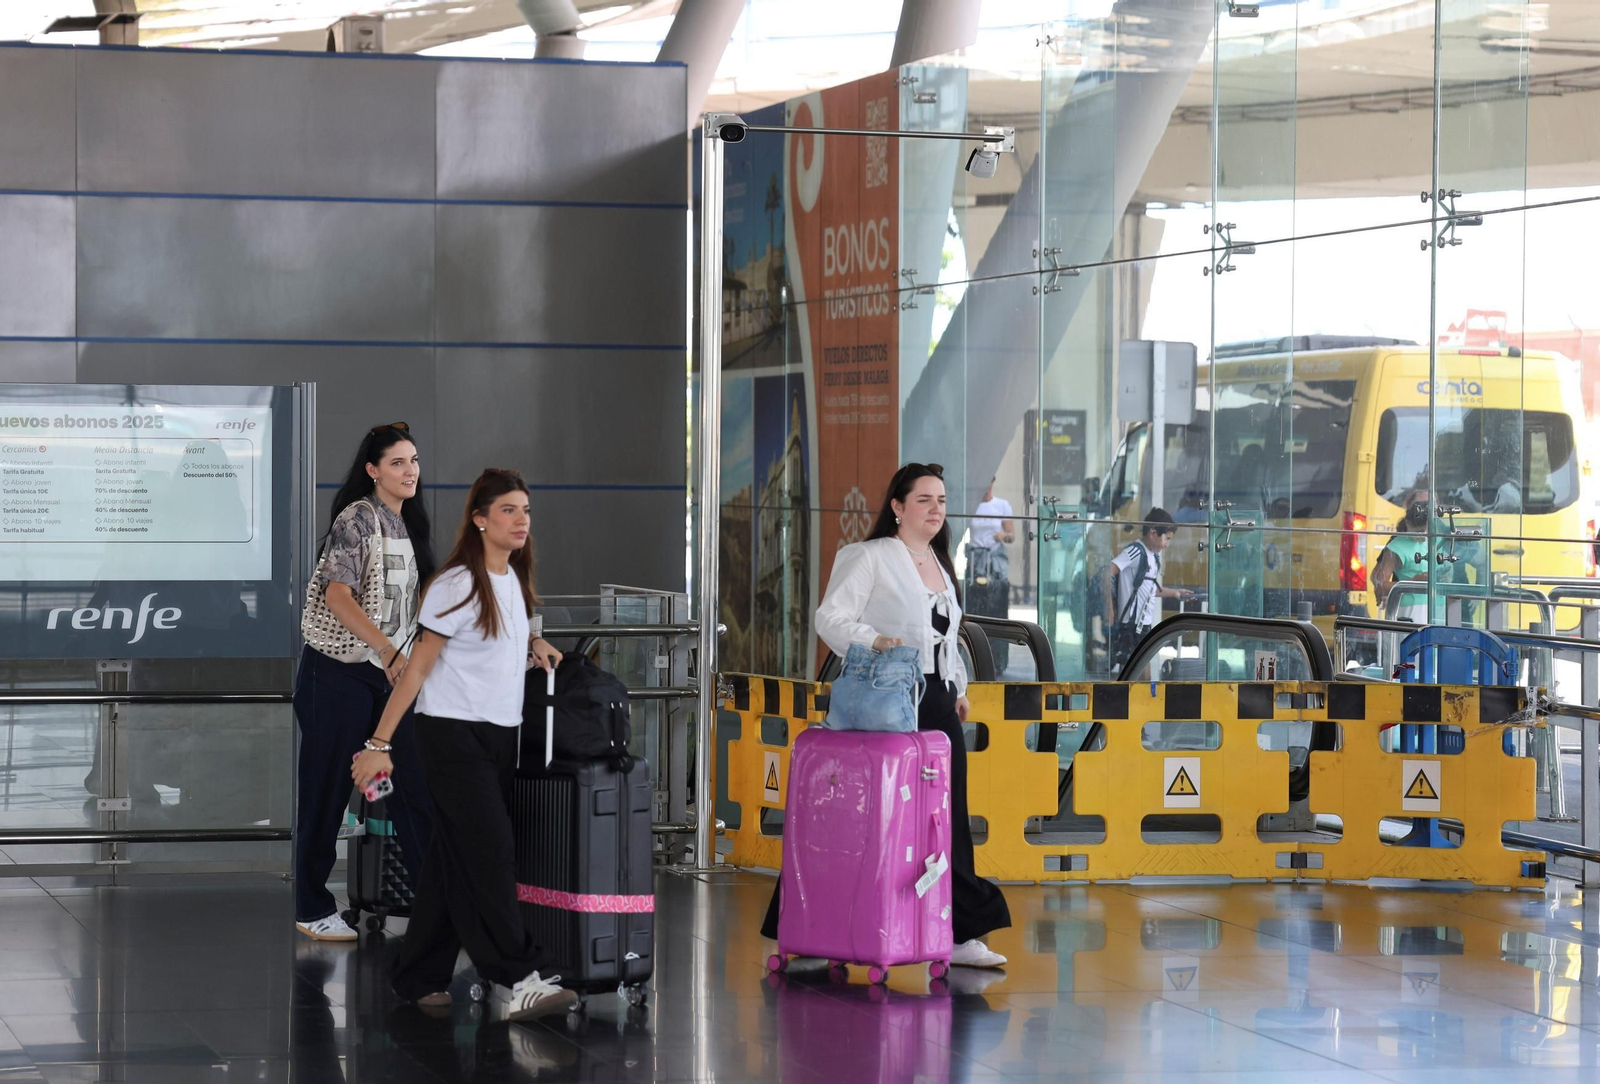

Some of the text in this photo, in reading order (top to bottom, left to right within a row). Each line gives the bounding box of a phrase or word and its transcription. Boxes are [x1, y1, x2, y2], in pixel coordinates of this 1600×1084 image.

[824, 217, 890, 276] BONOS
[824, 279, 890, 320] TURÍSTICOS
[824, 344, 888, 364] VUELOS DIRECTOS
[53, 414, 118, 429] abonos
[122, 415, 164, 429] 2025
[215, 417, 256, 433] renfe
[2, 445, 37, 453] Cercanías
[94, 446, 154, 454] Media Distancia
[42, 518, 62, 526] viajes
[46, 592, 182, 645] renfe
